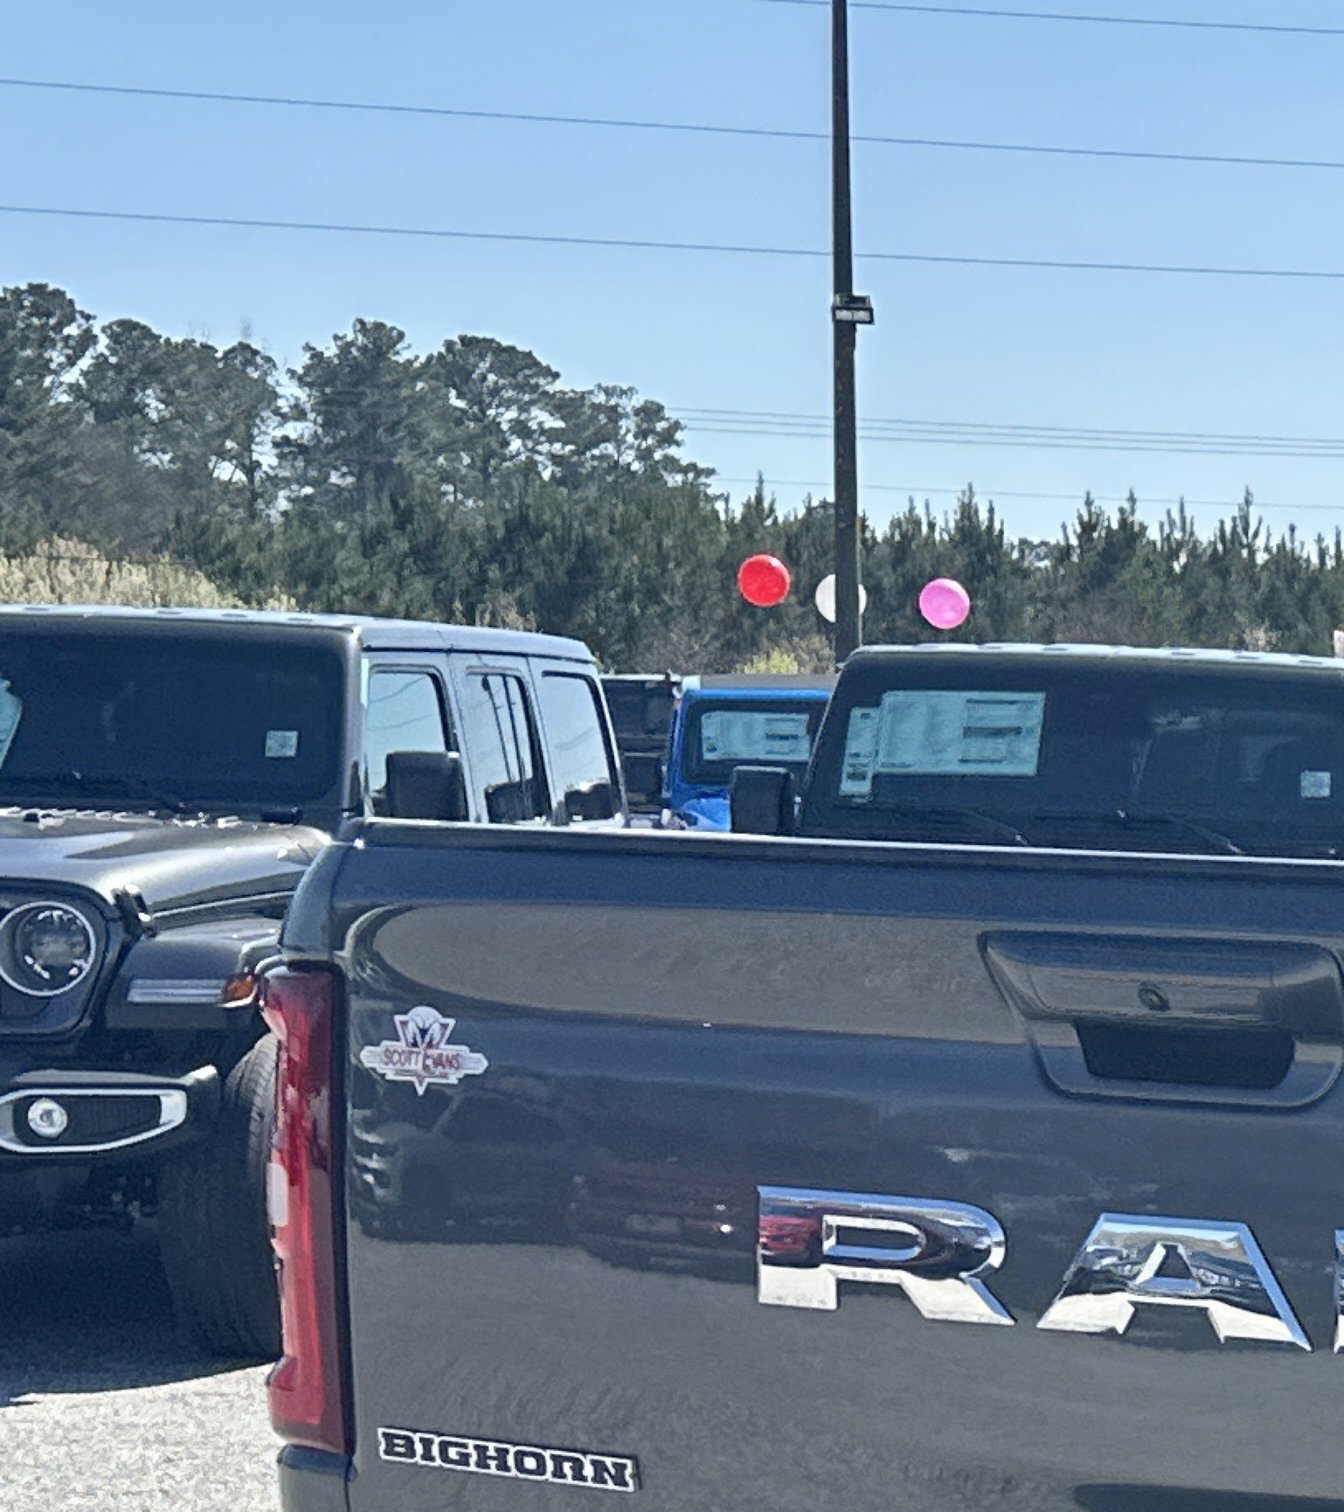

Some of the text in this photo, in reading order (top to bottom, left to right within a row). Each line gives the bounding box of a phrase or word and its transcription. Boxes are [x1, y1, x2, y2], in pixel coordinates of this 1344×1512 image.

[384, 1048, 461, 1073] SCOTT EVANS
[377, 1427, 636, 1492] BIGHORN
